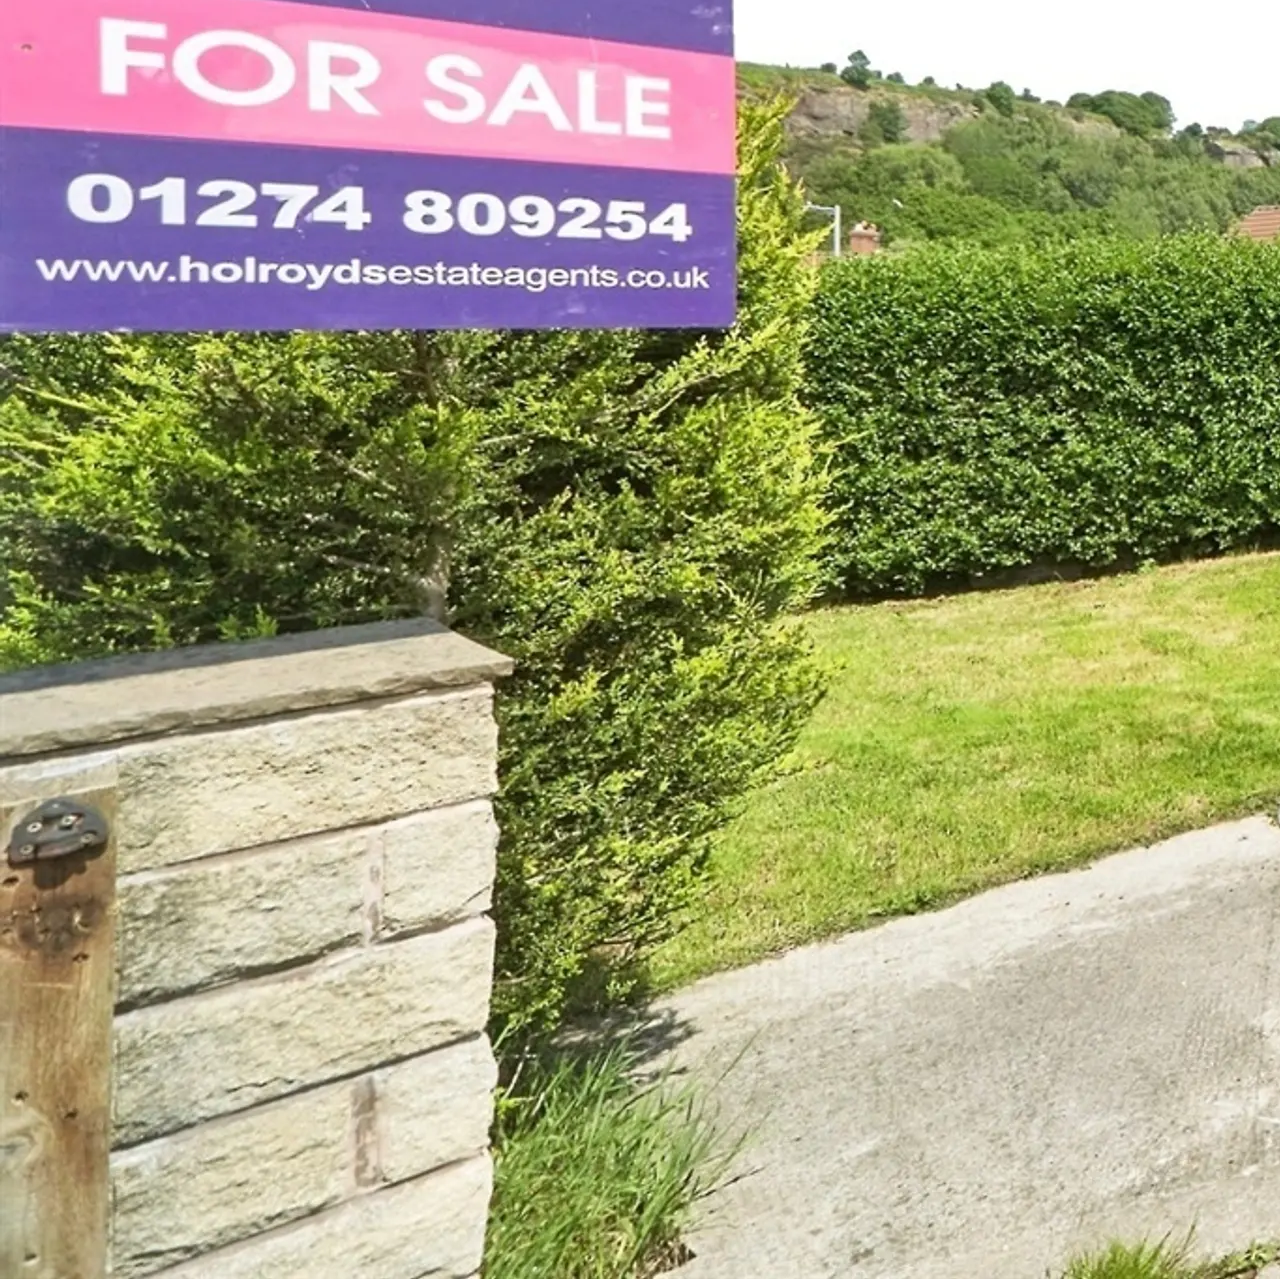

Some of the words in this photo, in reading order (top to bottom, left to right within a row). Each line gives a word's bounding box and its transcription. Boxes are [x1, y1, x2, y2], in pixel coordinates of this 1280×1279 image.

[99, 16, 382, 116] FOR
[423, 53, 671, 140] SALE
[66, 173, 372, 231] 01274
[403, 190, 692, 242] 809254
[35, 255, 710, 292] www.holroydsestateagents.co.uk
